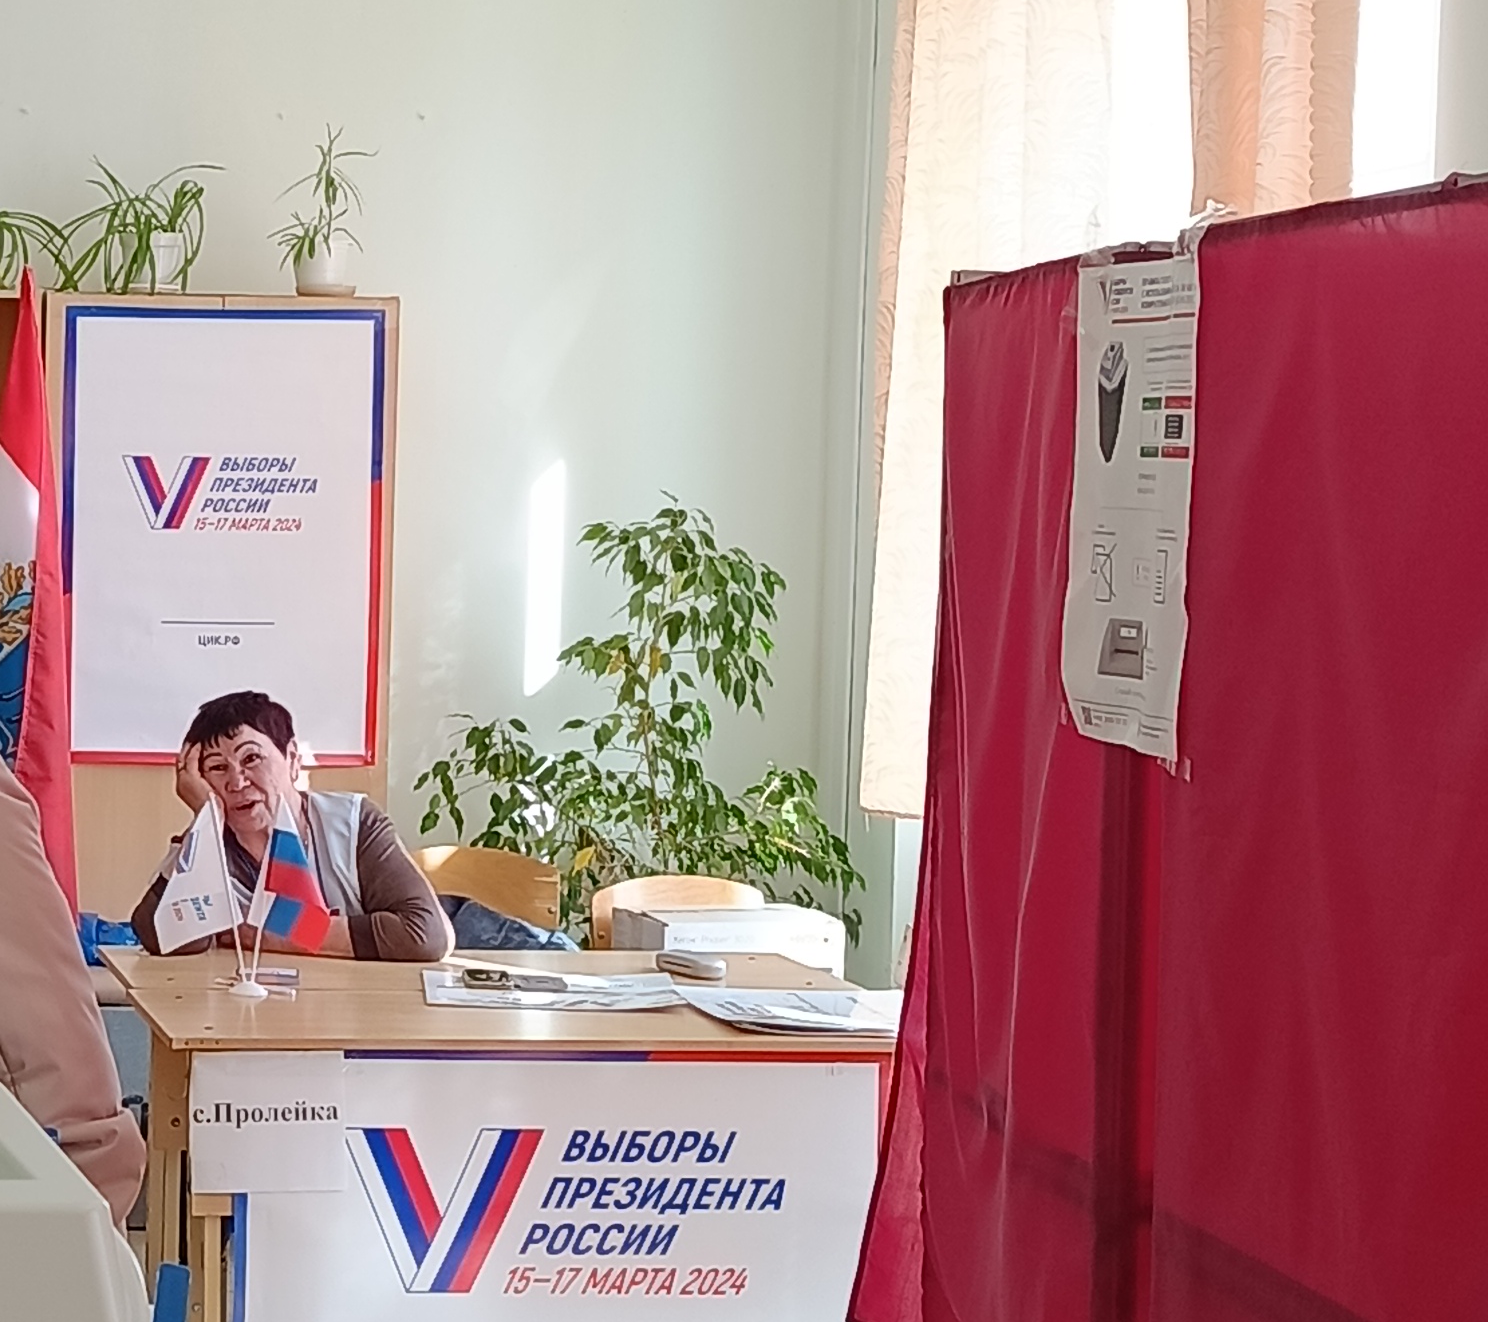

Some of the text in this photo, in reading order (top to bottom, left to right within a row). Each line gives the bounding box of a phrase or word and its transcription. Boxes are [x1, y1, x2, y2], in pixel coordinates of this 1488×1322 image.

[219, 457, 296, 472] ВЫБОРЫ
[210, 477, 318, 495] ПРЕЗИДЕНТА
[200, 498, 271, 513] РОССИИ
[228, 517, 271, 531] МАРТА
[272, 517, 302, 531] 2024
[193, 1100, 338, 1129] с.Пролейка
[561, 1130, 737, 1163] ВЫБОРЫ
[540, 1177, 786, 1215] ПРЕЗИДЕНТА
[518, 1223, 679, 1256] РОССИИ
[581, 1267, 678, 1295] МАРТА
[679, 1267, 748, 1296] 2024
